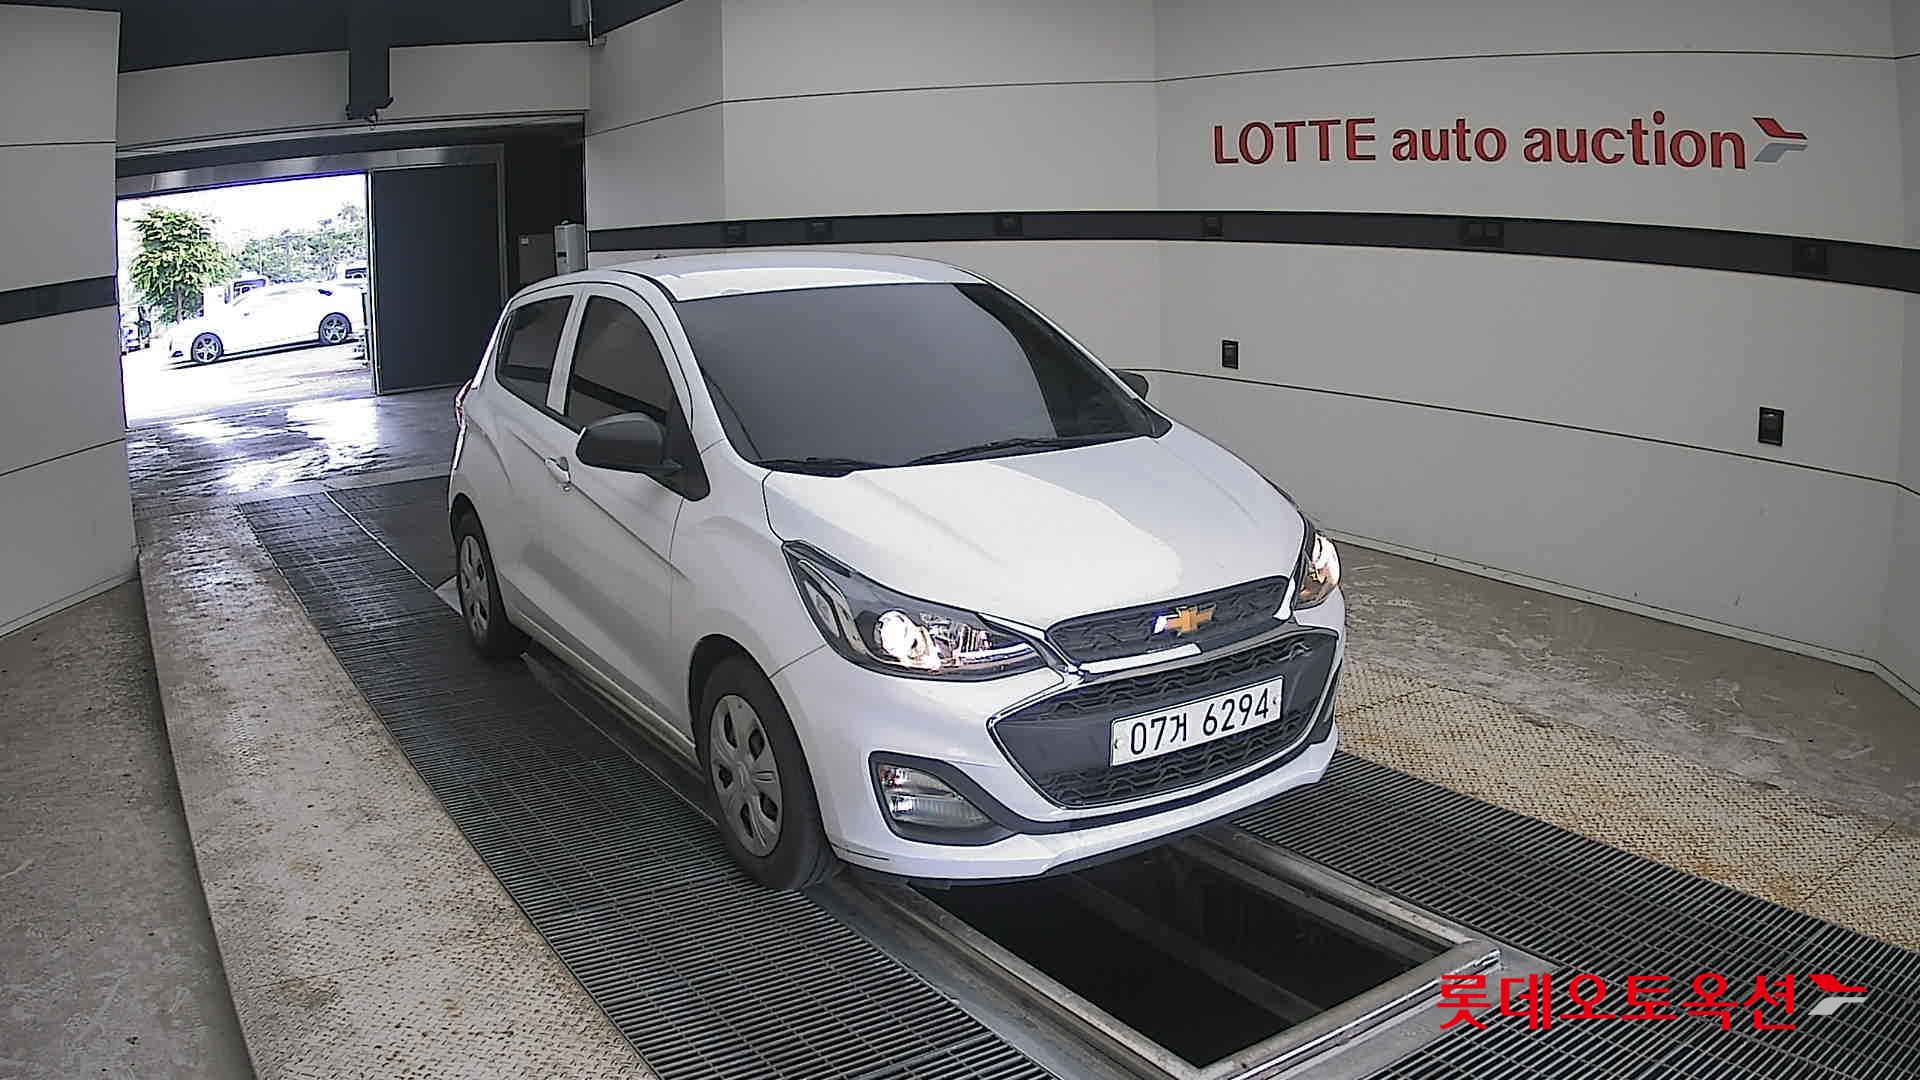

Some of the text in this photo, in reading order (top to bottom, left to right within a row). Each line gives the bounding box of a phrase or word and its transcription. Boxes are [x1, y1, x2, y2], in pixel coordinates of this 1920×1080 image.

[1213, 111, 1746, 169] LOTTE auto auction
[1130, 687, 1269, 755] 07거 6294
